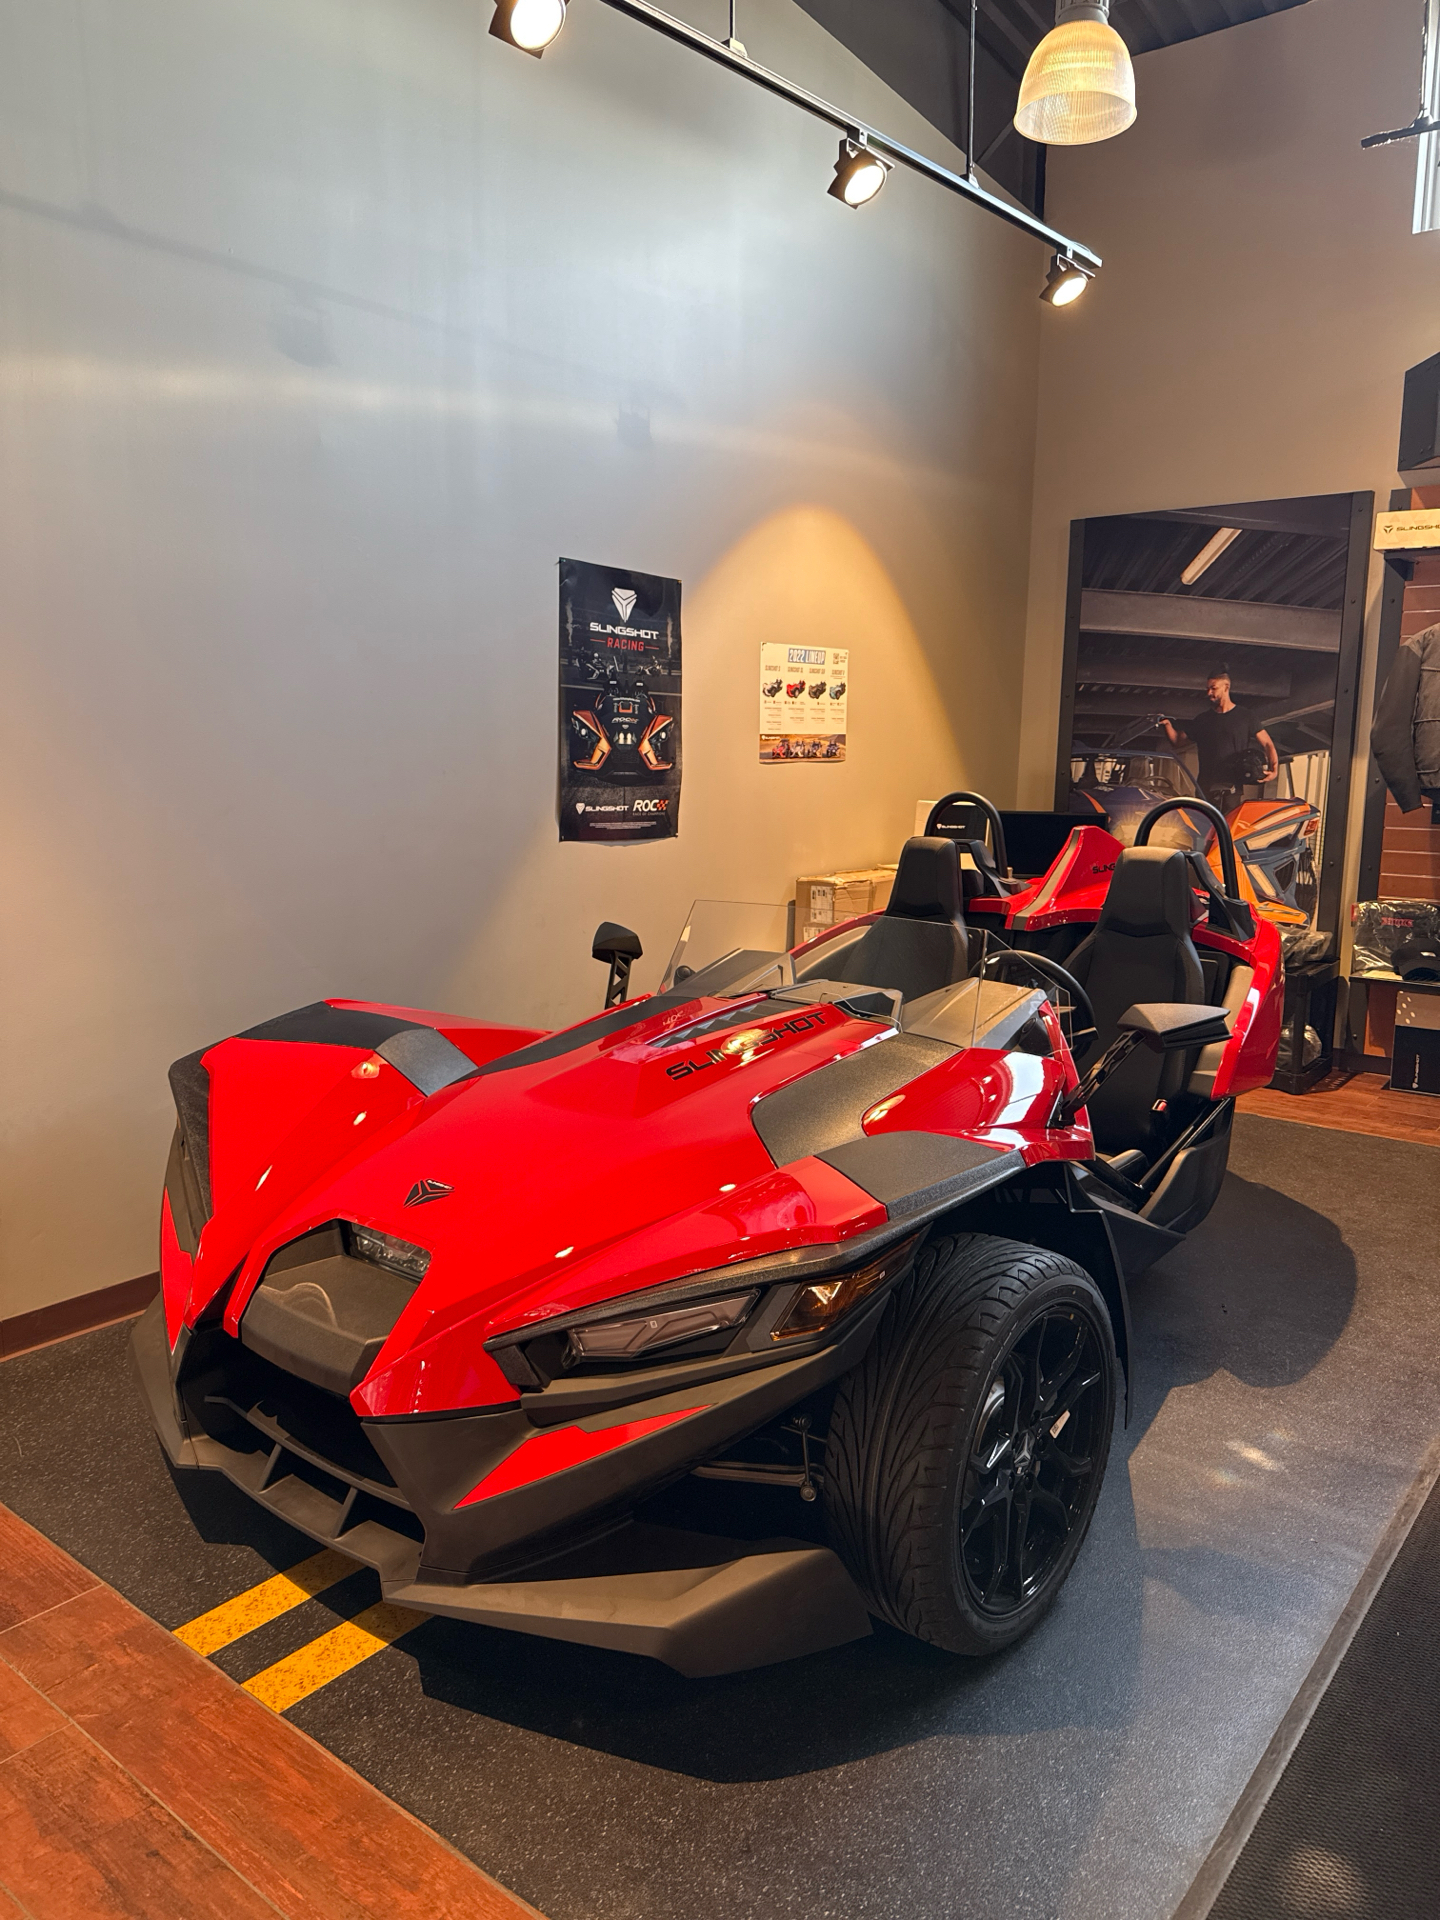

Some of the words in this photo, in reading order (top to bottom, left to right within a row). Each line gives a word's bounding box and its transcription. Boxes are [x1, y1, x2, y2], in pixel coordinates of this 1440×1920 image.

[589, 621, 660, 640] SLINGSHOT
[606, 636, 645, 652] RACING
[789, 649, 805, 663] 2022
[805, 650, 826, 665] LINEUP
[1092, 862, 1116, 874] SLING
[665, 1011, 828, 1081] SLINGSHOT
